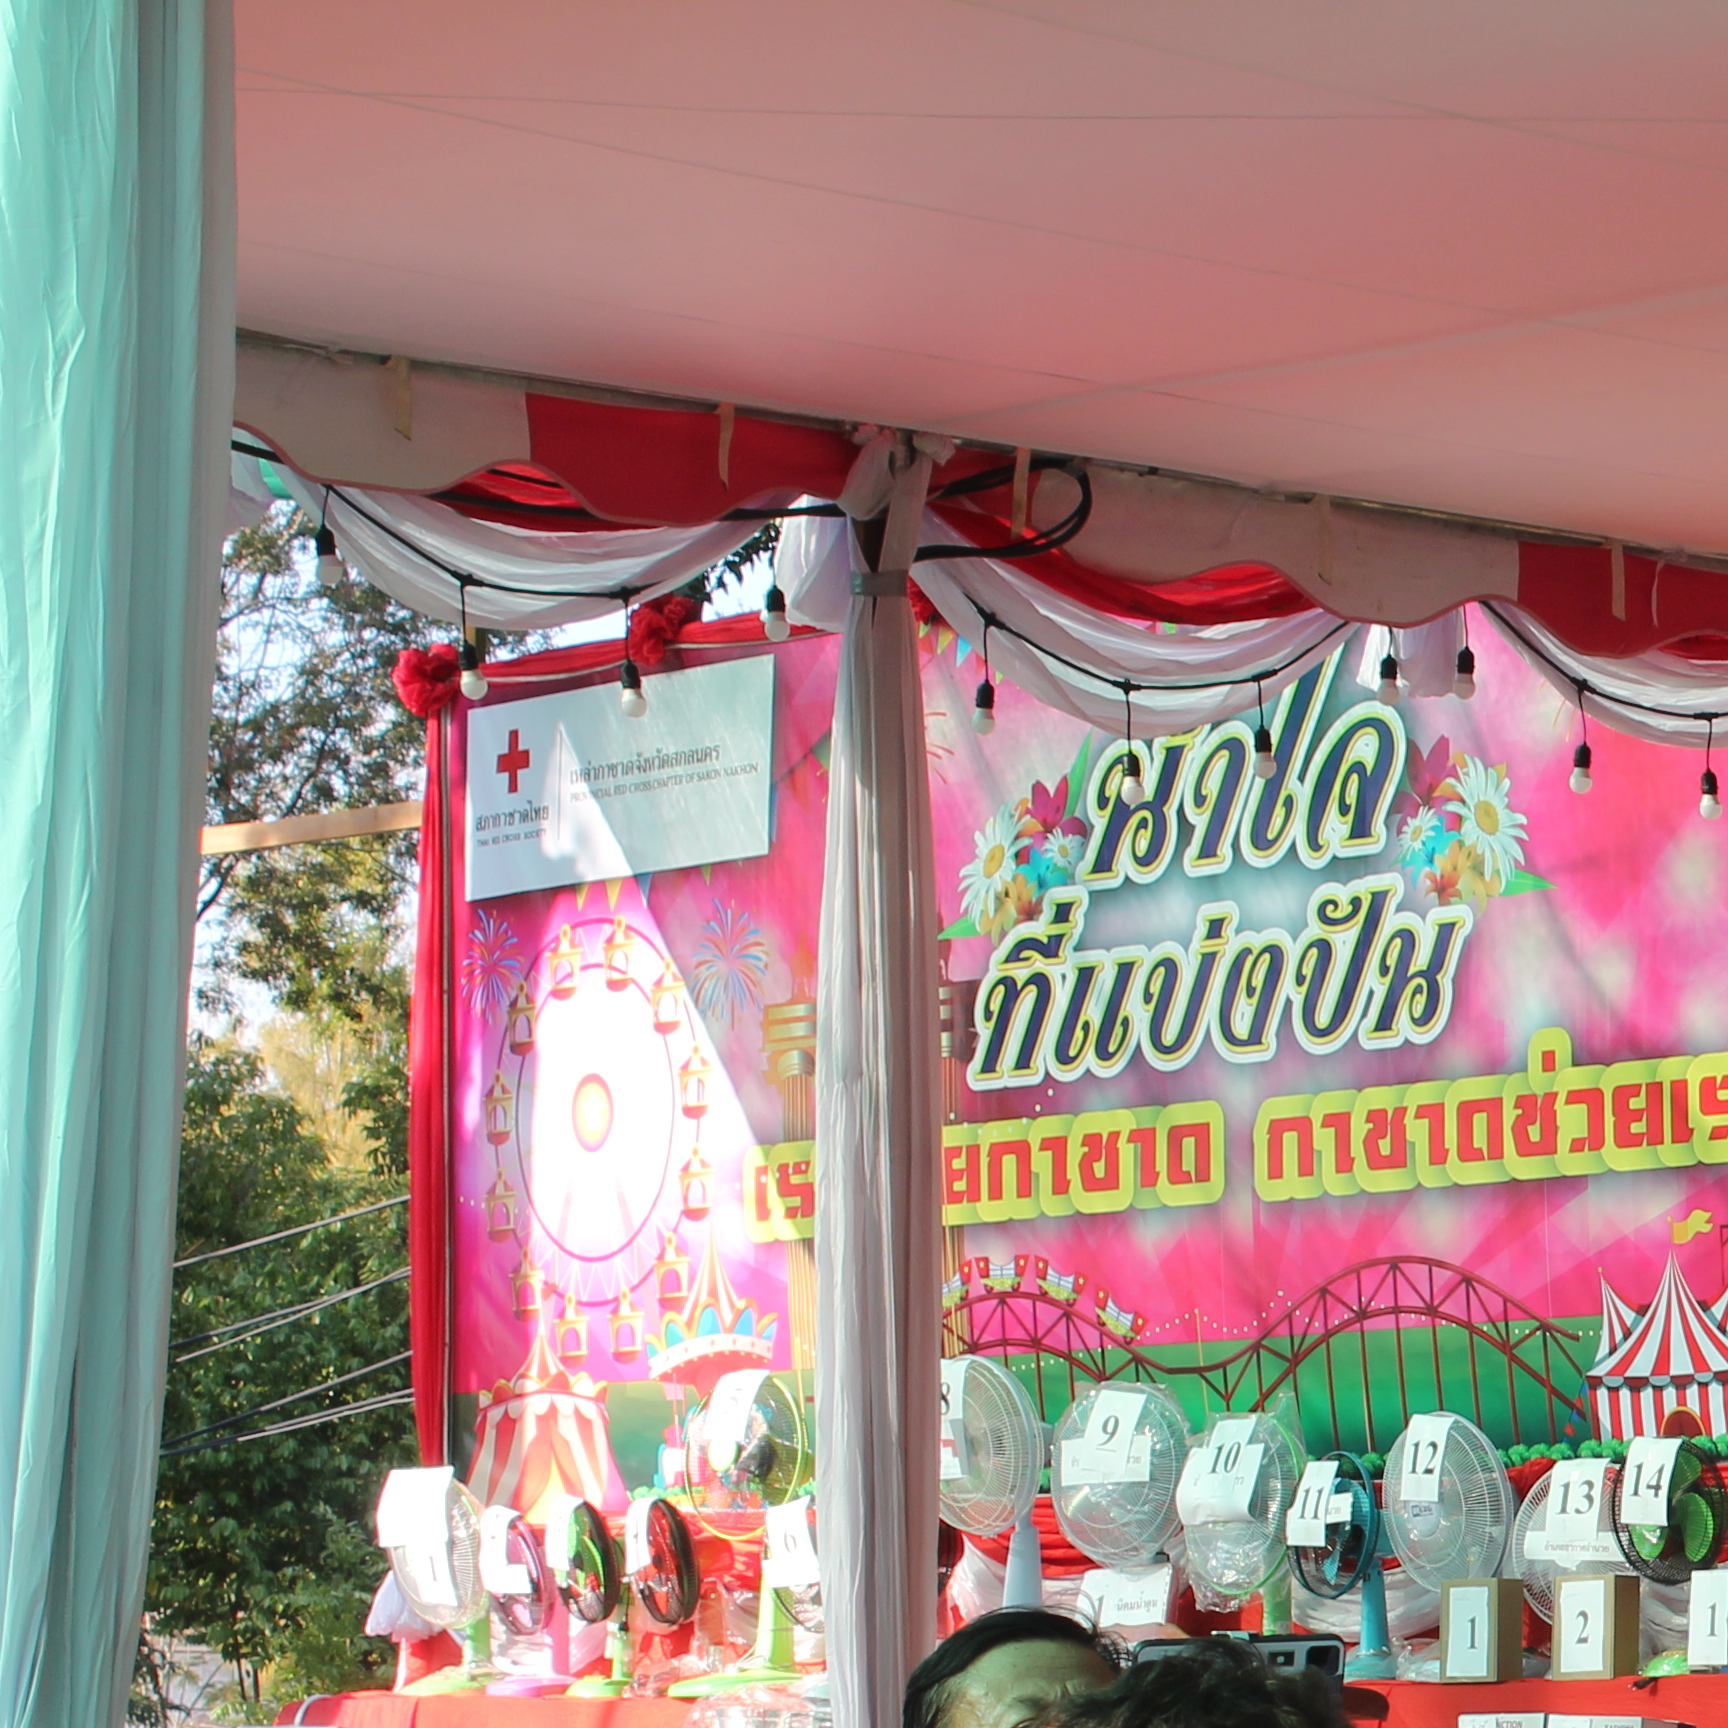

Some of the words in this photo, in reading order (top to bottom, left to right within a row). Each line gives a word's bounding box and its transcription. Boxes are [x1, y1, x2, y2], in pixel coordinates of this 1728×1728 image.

[613, 784, 627, 796] RED
[628, 780, 652, 794] CROSS
[652, 776, 684, 791] CHAPTER
[685, 773, 695, 784] OF
[697, 767, 722, 783] SAKON
[723, 762, 760, 779] NAKHON
[475, 800, 549, 832] สภากาชาดไทย
[984, 887, 1465, 1080] ที่แบ่งปัน
[1096, 1414, 1120, 1447] 9
[1209, 1441, 1242, 1475] 10
[1408, 1439, 1438, 1475] 12
[1554, 1479, 1596, 1516] 13
[1628, 1461, 1664, 1499] 14
[1297, 1485, 1325, 1520] 11
[1466, 1615, 1479, 1650] 1
[1575, 1609, 1591, 1645] 2
[1706, 1602, 1718, 1637] 1
